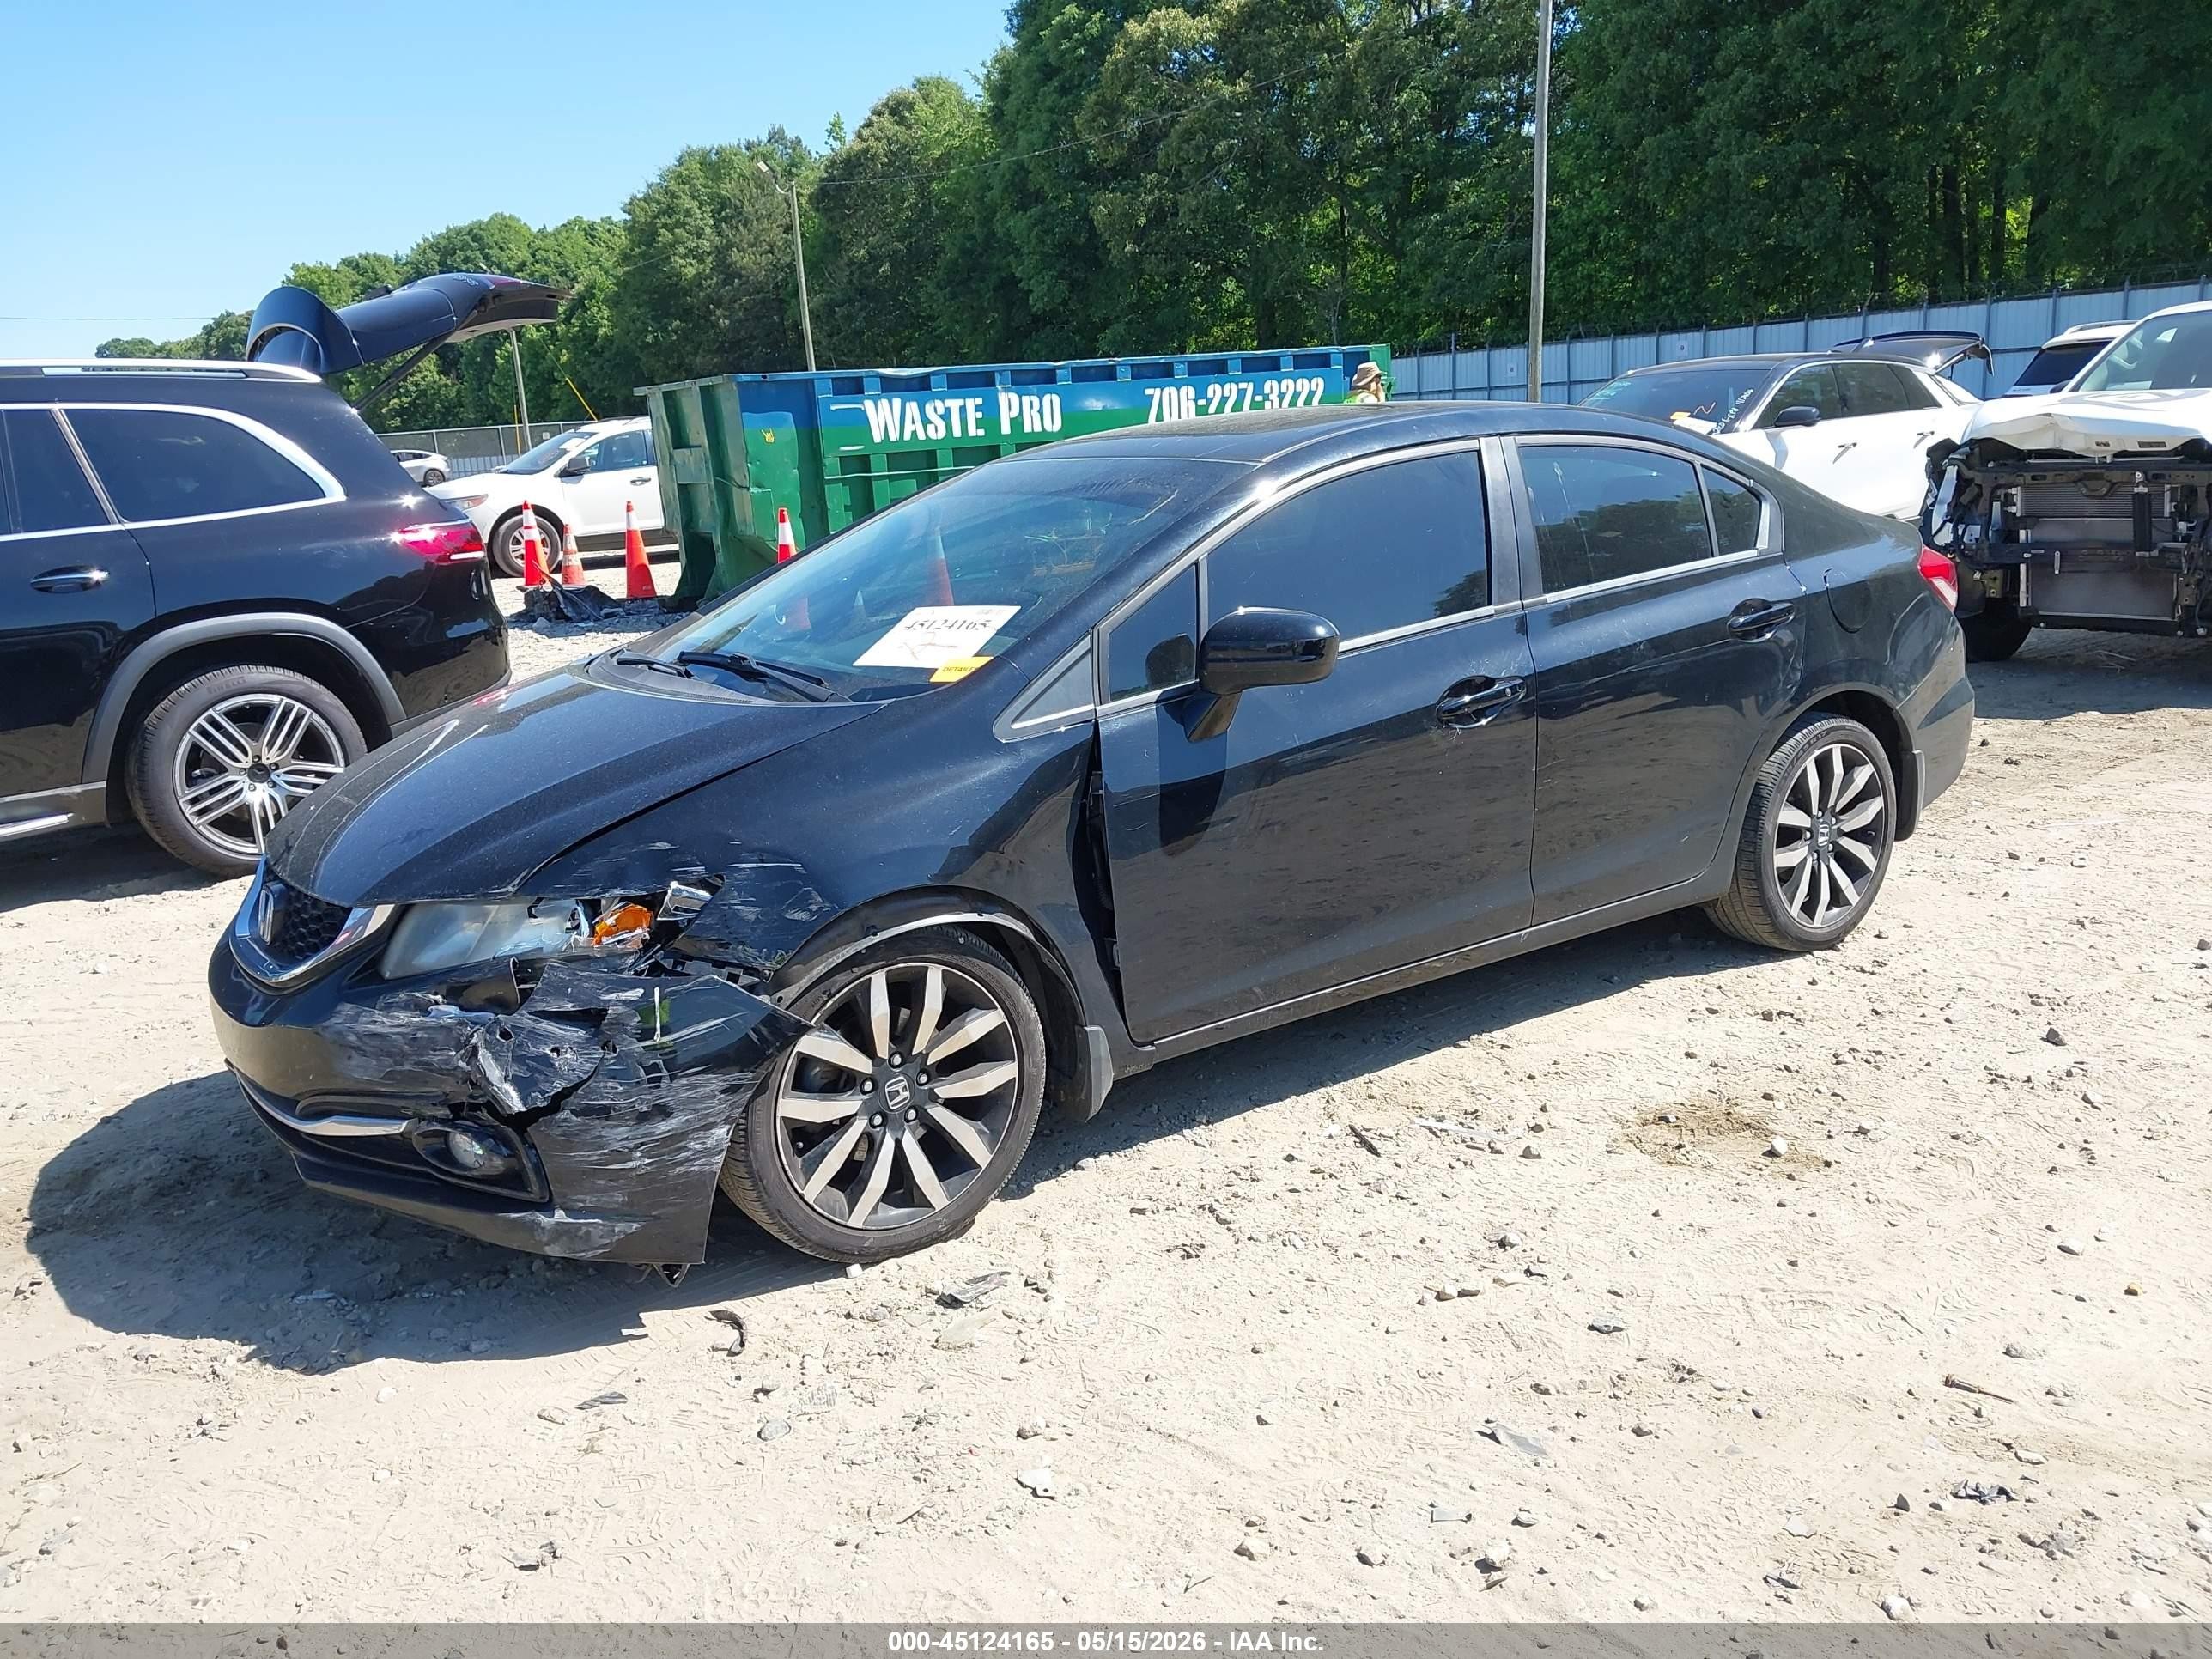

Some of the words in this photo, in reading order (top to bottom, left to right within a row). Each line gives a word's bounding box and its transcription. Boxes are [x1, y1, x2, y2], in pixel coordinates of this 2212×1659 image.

[863, 398, 986, 443] WASTE
[998, 392, 1062, 434] PRO
[1145, 376, 1325, 424] 706-227-3222
